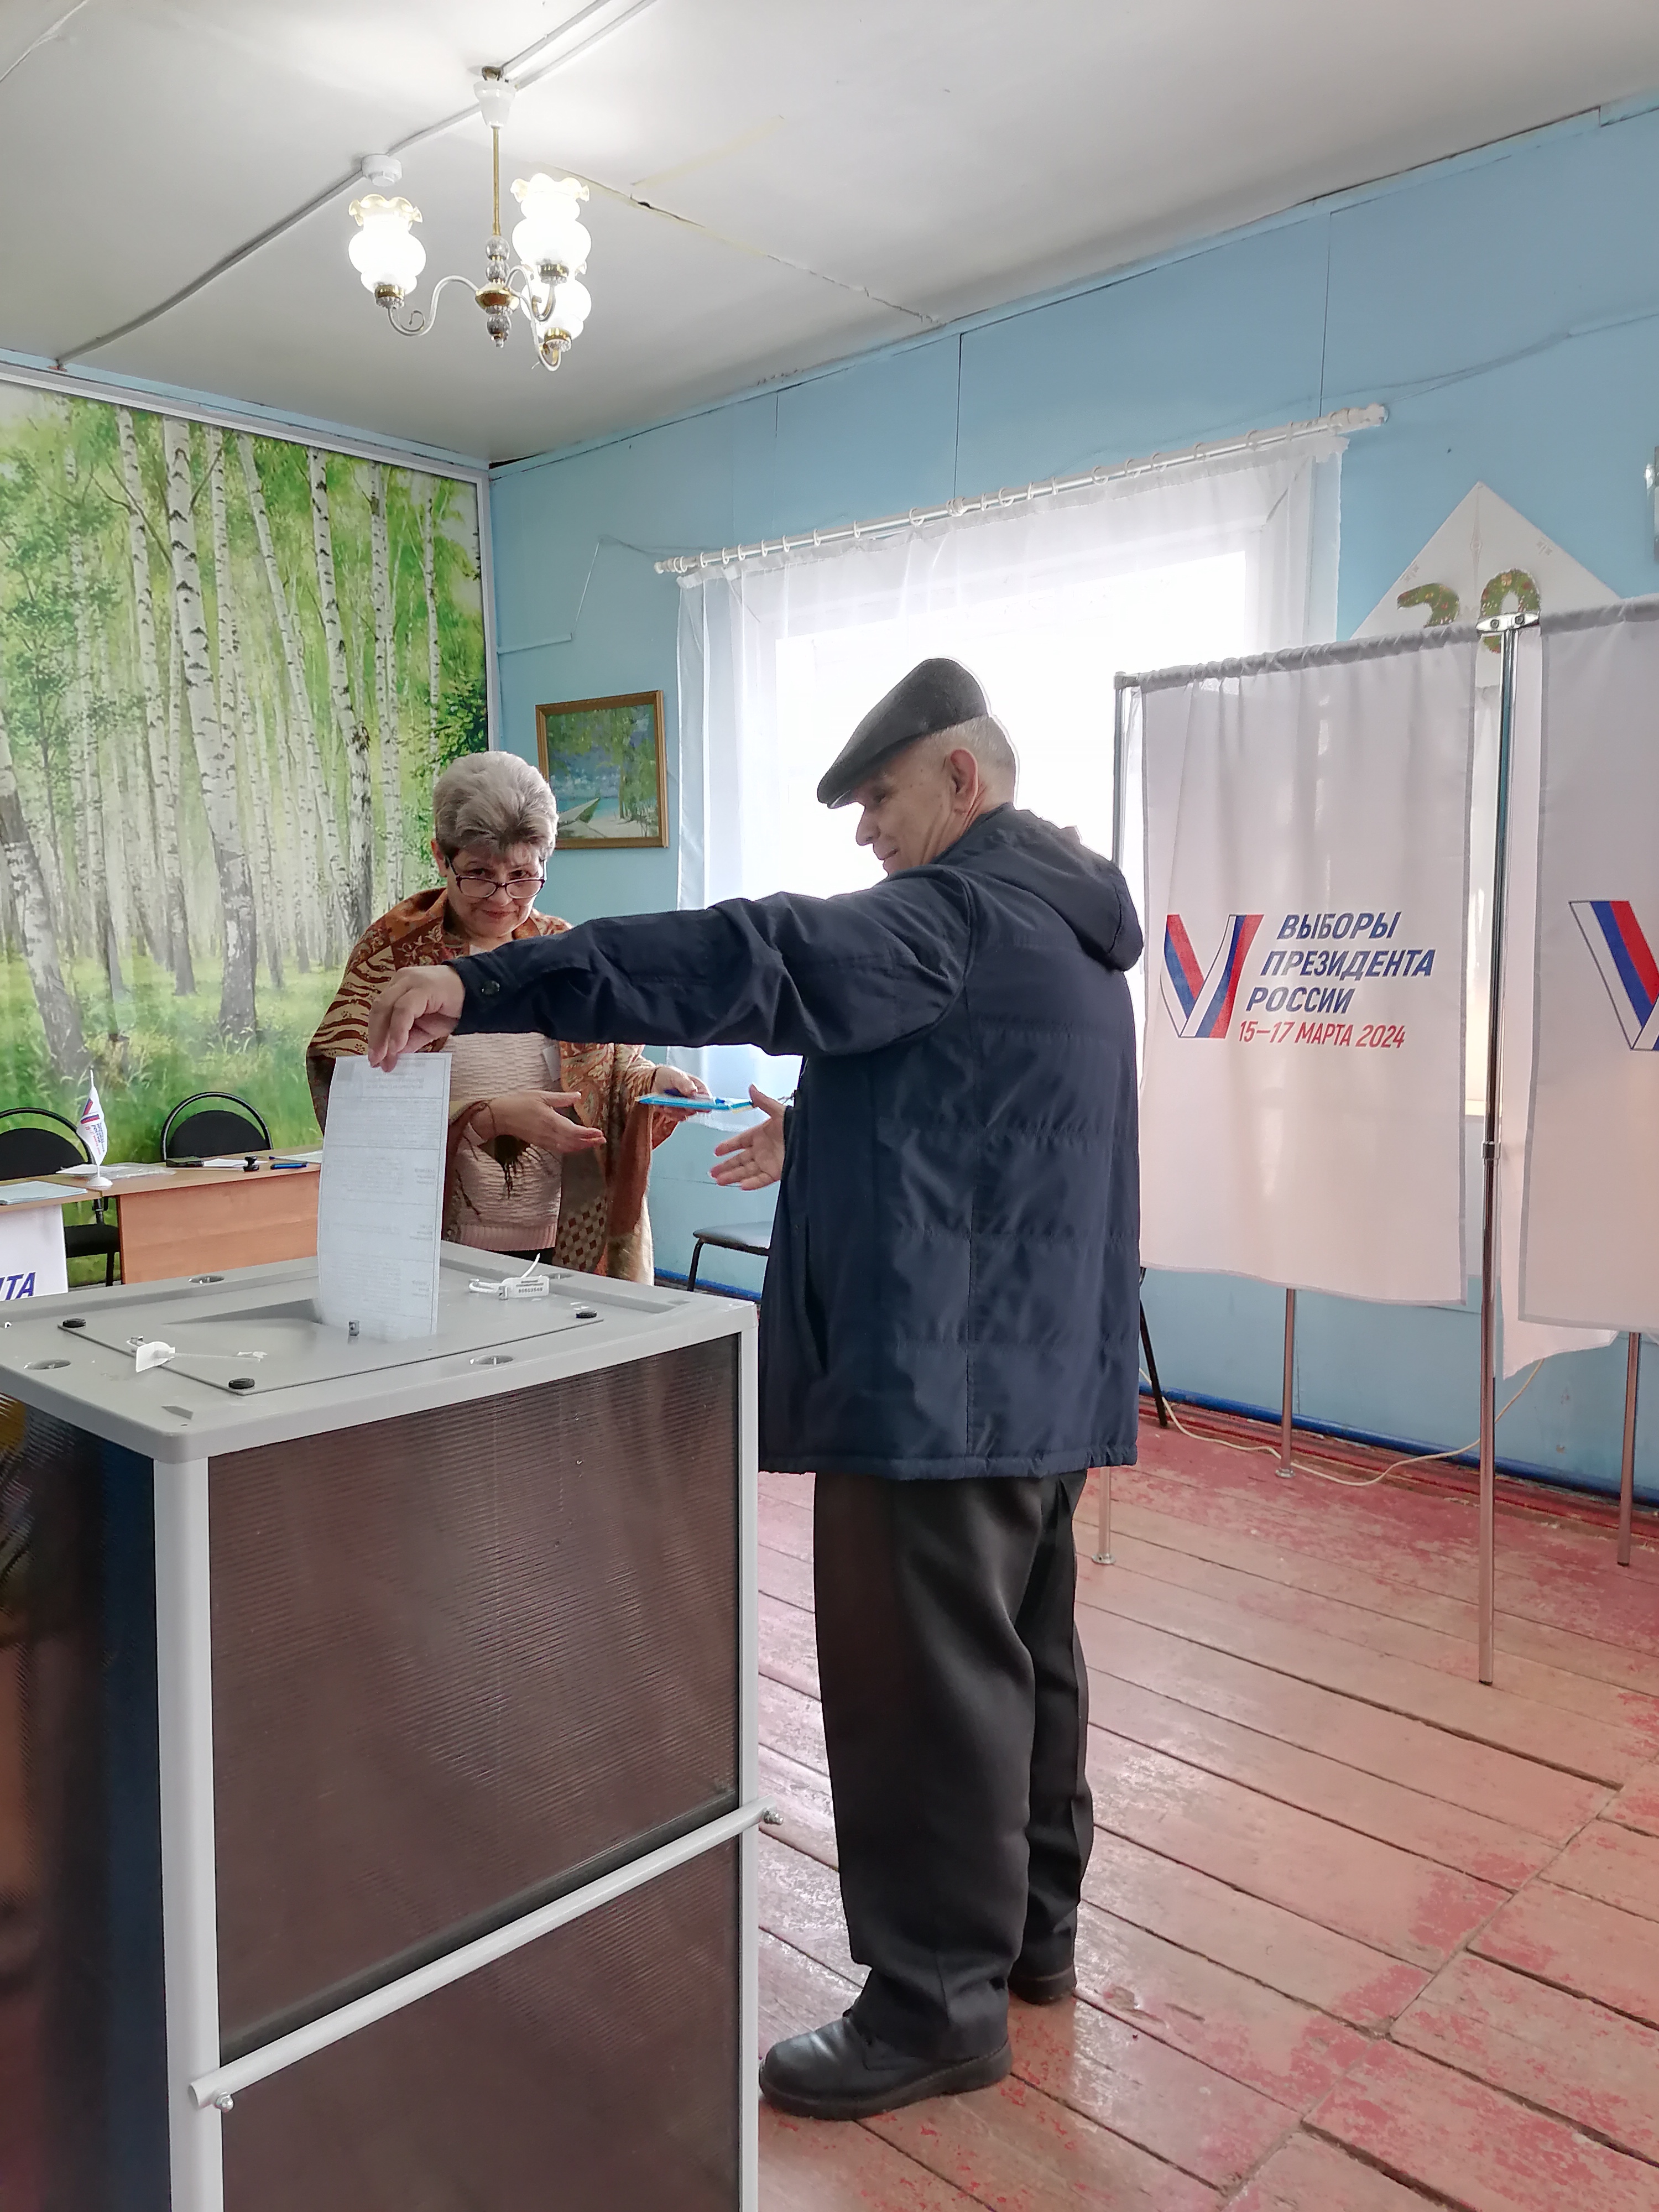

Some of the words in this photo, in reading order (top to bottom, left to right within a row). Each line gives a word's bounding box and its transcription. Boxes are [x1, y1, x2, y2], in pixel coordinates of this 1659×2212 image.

[1277, 912, 1402, 940] ВЫБОРЫ
[1260, 949, 1436, 981] ПРЕЗИДЕНТА
[1246, 987, 1355, 1014] РОССИИ
[1295, 1022, 1355, 1047] МАРТА
[1355, 1024, 1405, 1048] 2024
